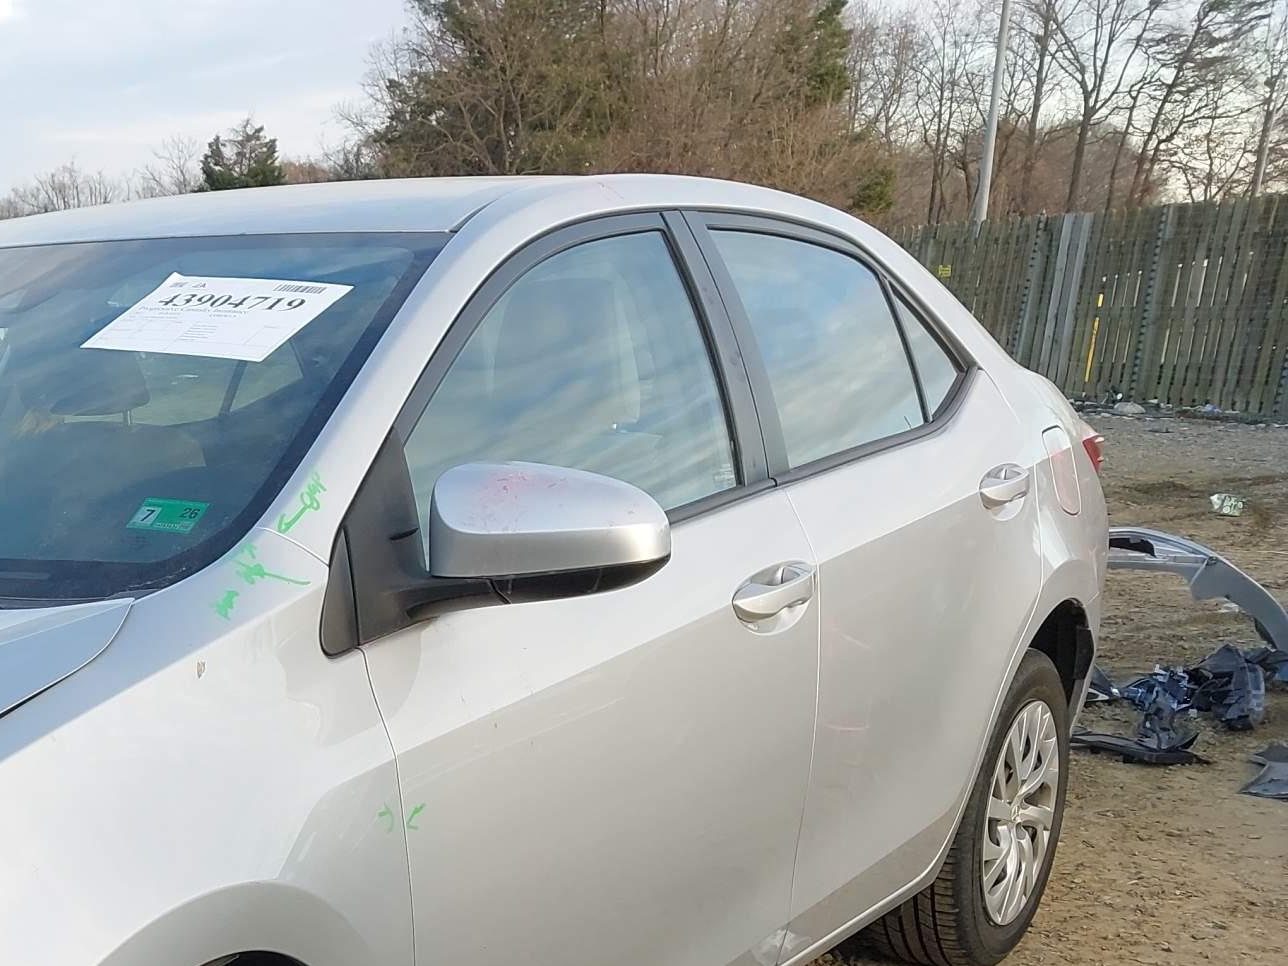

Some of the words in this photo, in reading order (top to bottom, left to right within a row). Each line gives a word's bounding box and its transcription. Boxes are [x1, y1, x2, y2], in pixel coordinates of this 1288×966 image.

[158, 293, 306, 312] 43904719
[140, 509, 155, 522] 7
[179, 507, 201, 519] 26
